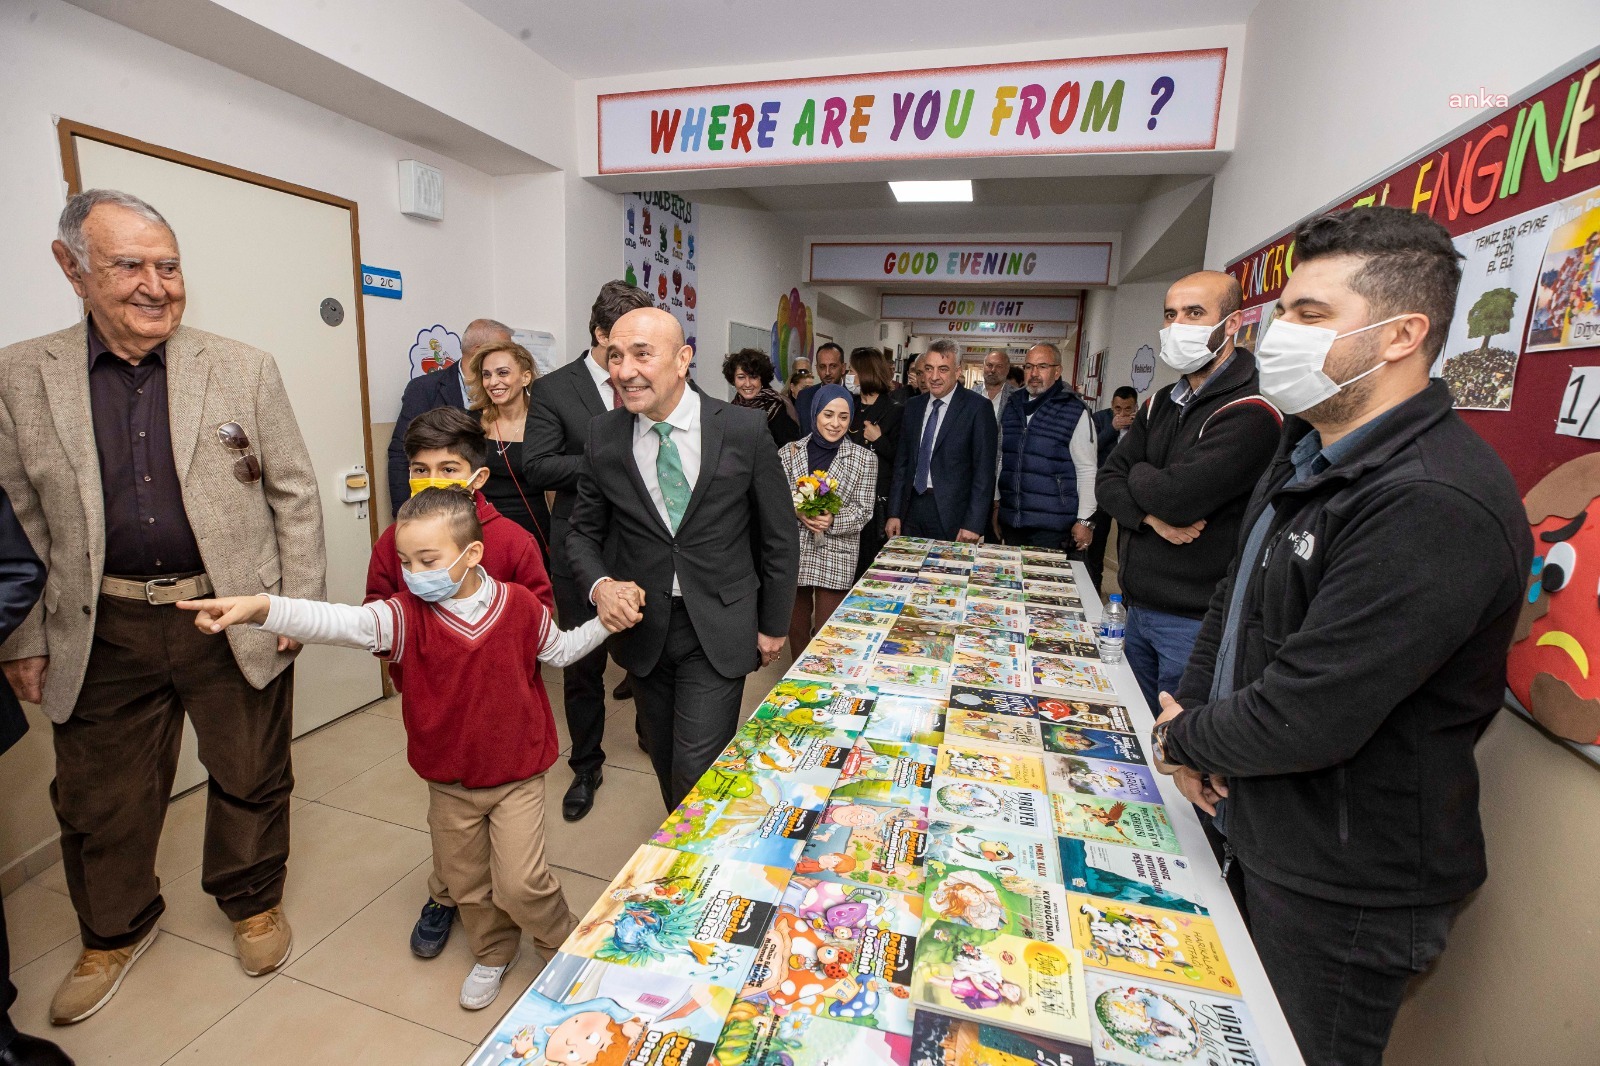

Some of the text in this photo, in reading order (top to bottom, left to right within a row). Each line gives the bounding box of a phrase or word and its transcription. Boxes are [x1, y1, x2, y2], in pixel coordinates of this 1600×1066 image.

[648, 76, 1175, 155] WHERE ARE YOU FROM ?
[1475, 215, 1549, 249] TEMİZ BİR ÇEVRE
[1494, 241, 1515, 257] İÇİN
[883, 251, 1037, 275] GOOD EVENING
[1487, 254, 1515, 273] EL ELE
[380, 278, 393, 288] 2/C
[938, 300, 1024, 316] GOOD NIGHT
[948, 321, 978, 332] GOOD
[1018, 791, 1034, 827] YÜRÜYEN
[905, 830, 918, 865] Değerler
[695, 890, 732, 940] Nezaket
[723, 897, 750, 942] Değerler
[1042, 890, 1055, 943] KUYRUĞUNDA
[858, 928, 877, 975] Dostluk
[883, 931, 901, 982] Değerler
